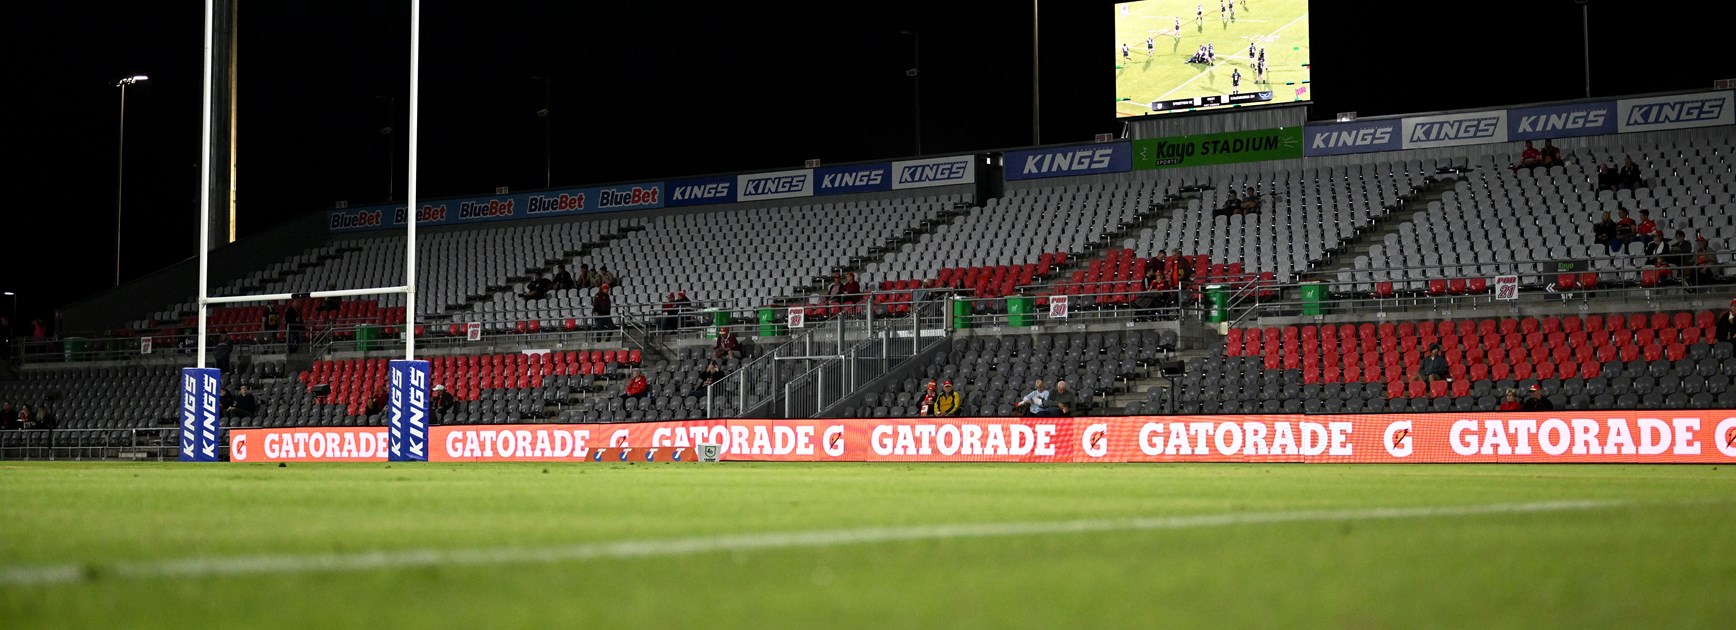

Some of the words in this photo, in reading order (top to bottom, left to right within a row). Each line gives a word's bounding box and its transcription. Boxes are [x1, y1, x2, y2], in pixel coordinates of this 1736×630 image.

[1517, 107, 1608, 133] KINGS
[1625, 97, 1726, 126] KINGS
[1312, 125, 1393, 148] KINGS
[1409, 115, 1500, 143] KINGS
[1022, 147, 1113, 174] KINGS
[1156, 140, 1195, 164] Kayo
[1200, 135, 1279, 155] STADIUM
[821, 169, 884, 189] KINGS
[899, 160, 968, 183] KINGS
[598, 187, 659, 208] BlueBet
[672, 180, 730, 200] KINGS
[743, 174, 806, 197] KINGS
[394, 204, 446, 225] BleBet
[459, 198, 514, 220] BlueBet
[527, 192, 585, 214] BlueBet
[330, 209, 382, 230] BlueBet
[1498, 285, 1516, 298] 21
[183, 373, 197, 458] KINGS
[202, 373, 217, 457] KINGS
[390, 366, 402, 456] KINGS
[409, 366, 425, 457] KINGS
[232, 434, 247, 460] G
[264, 432, 389, 459] GATORADE
[446, 430, 590, 458] GATORADE
[653, 424, 814, 455] GATORADE
[822, 424, 845, 457] G
[871, 424, 1056, 456] GATORADE
[1082, 422, 1108, 457] G
[1138, 421, 1353, 456] GATORADE
[1383, 419, 1413, 458] G
[1449, 417, 1701, 456] GATORADE
